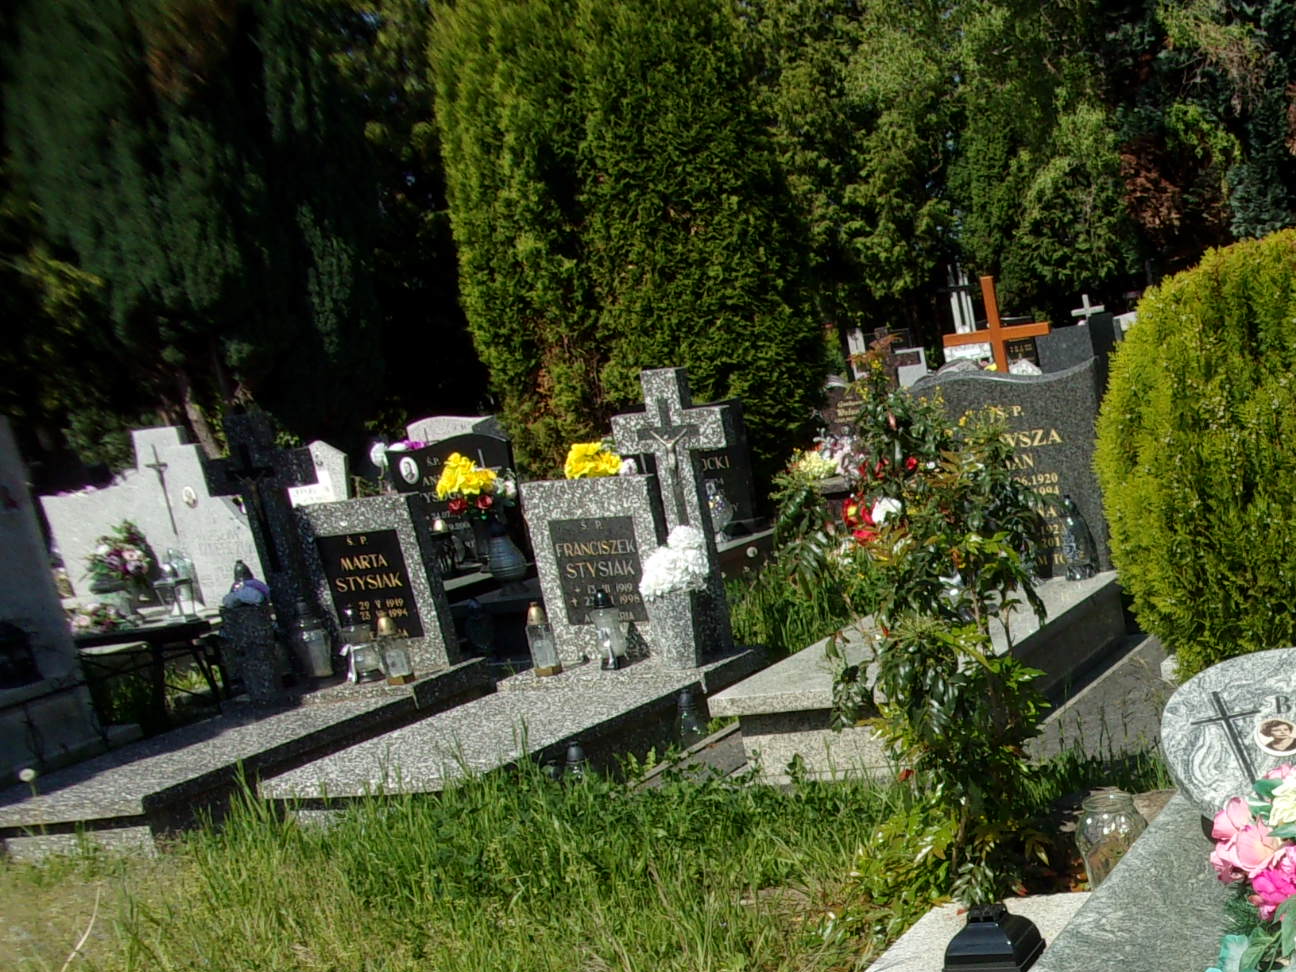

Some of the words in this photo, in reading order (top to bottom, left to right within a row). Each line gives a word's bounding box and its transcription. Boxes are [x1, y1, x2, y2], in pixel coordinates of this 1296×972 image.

[554, 539, 636, 558] FRANCISZEK
[340, 553, 389, 572] MARTA
[565, 559, 636, 580] STYSIAK
[335, 572, 404, 593] STYSIAK
